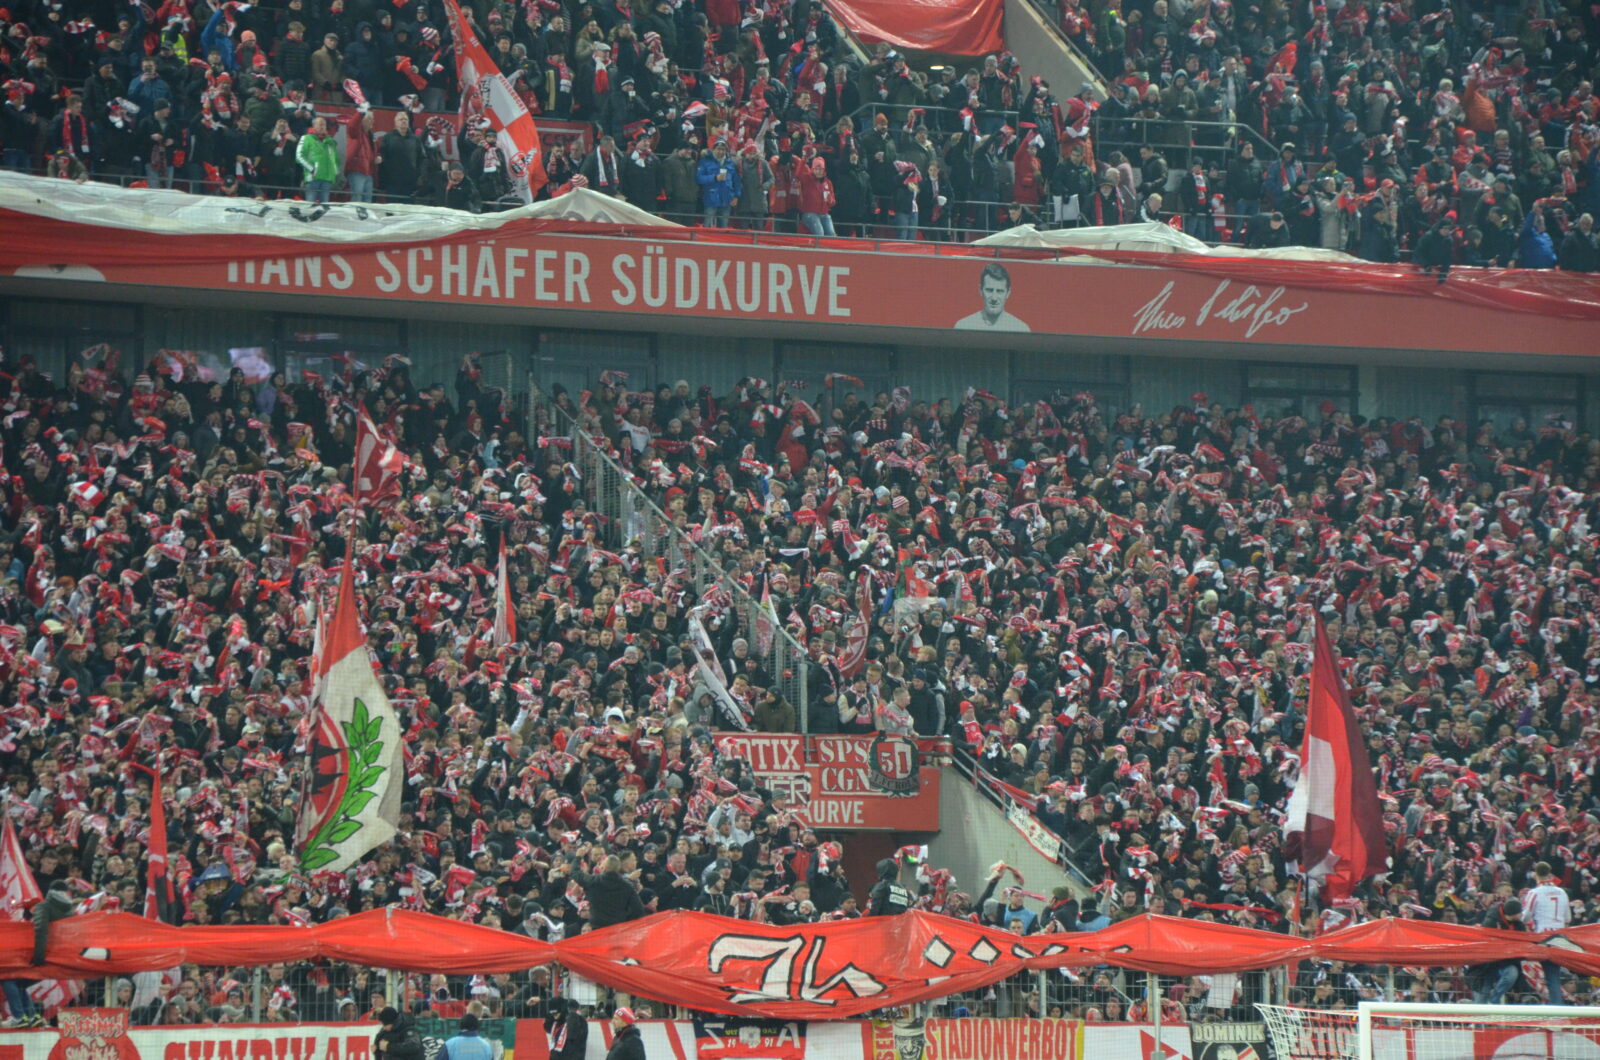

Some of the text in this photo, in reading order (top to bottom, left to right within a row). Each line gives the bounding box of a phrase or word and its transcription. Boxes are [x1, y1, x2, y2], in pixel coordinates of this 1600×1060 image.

[375, 239, 592, 303] SCHÄFER
[611, 245, 851, 317] SÜDKURVE
[925, 1017, 1078, 1060] STADIONVERBOT
[1194, 1025, 1265, 1042] DOMINIK
